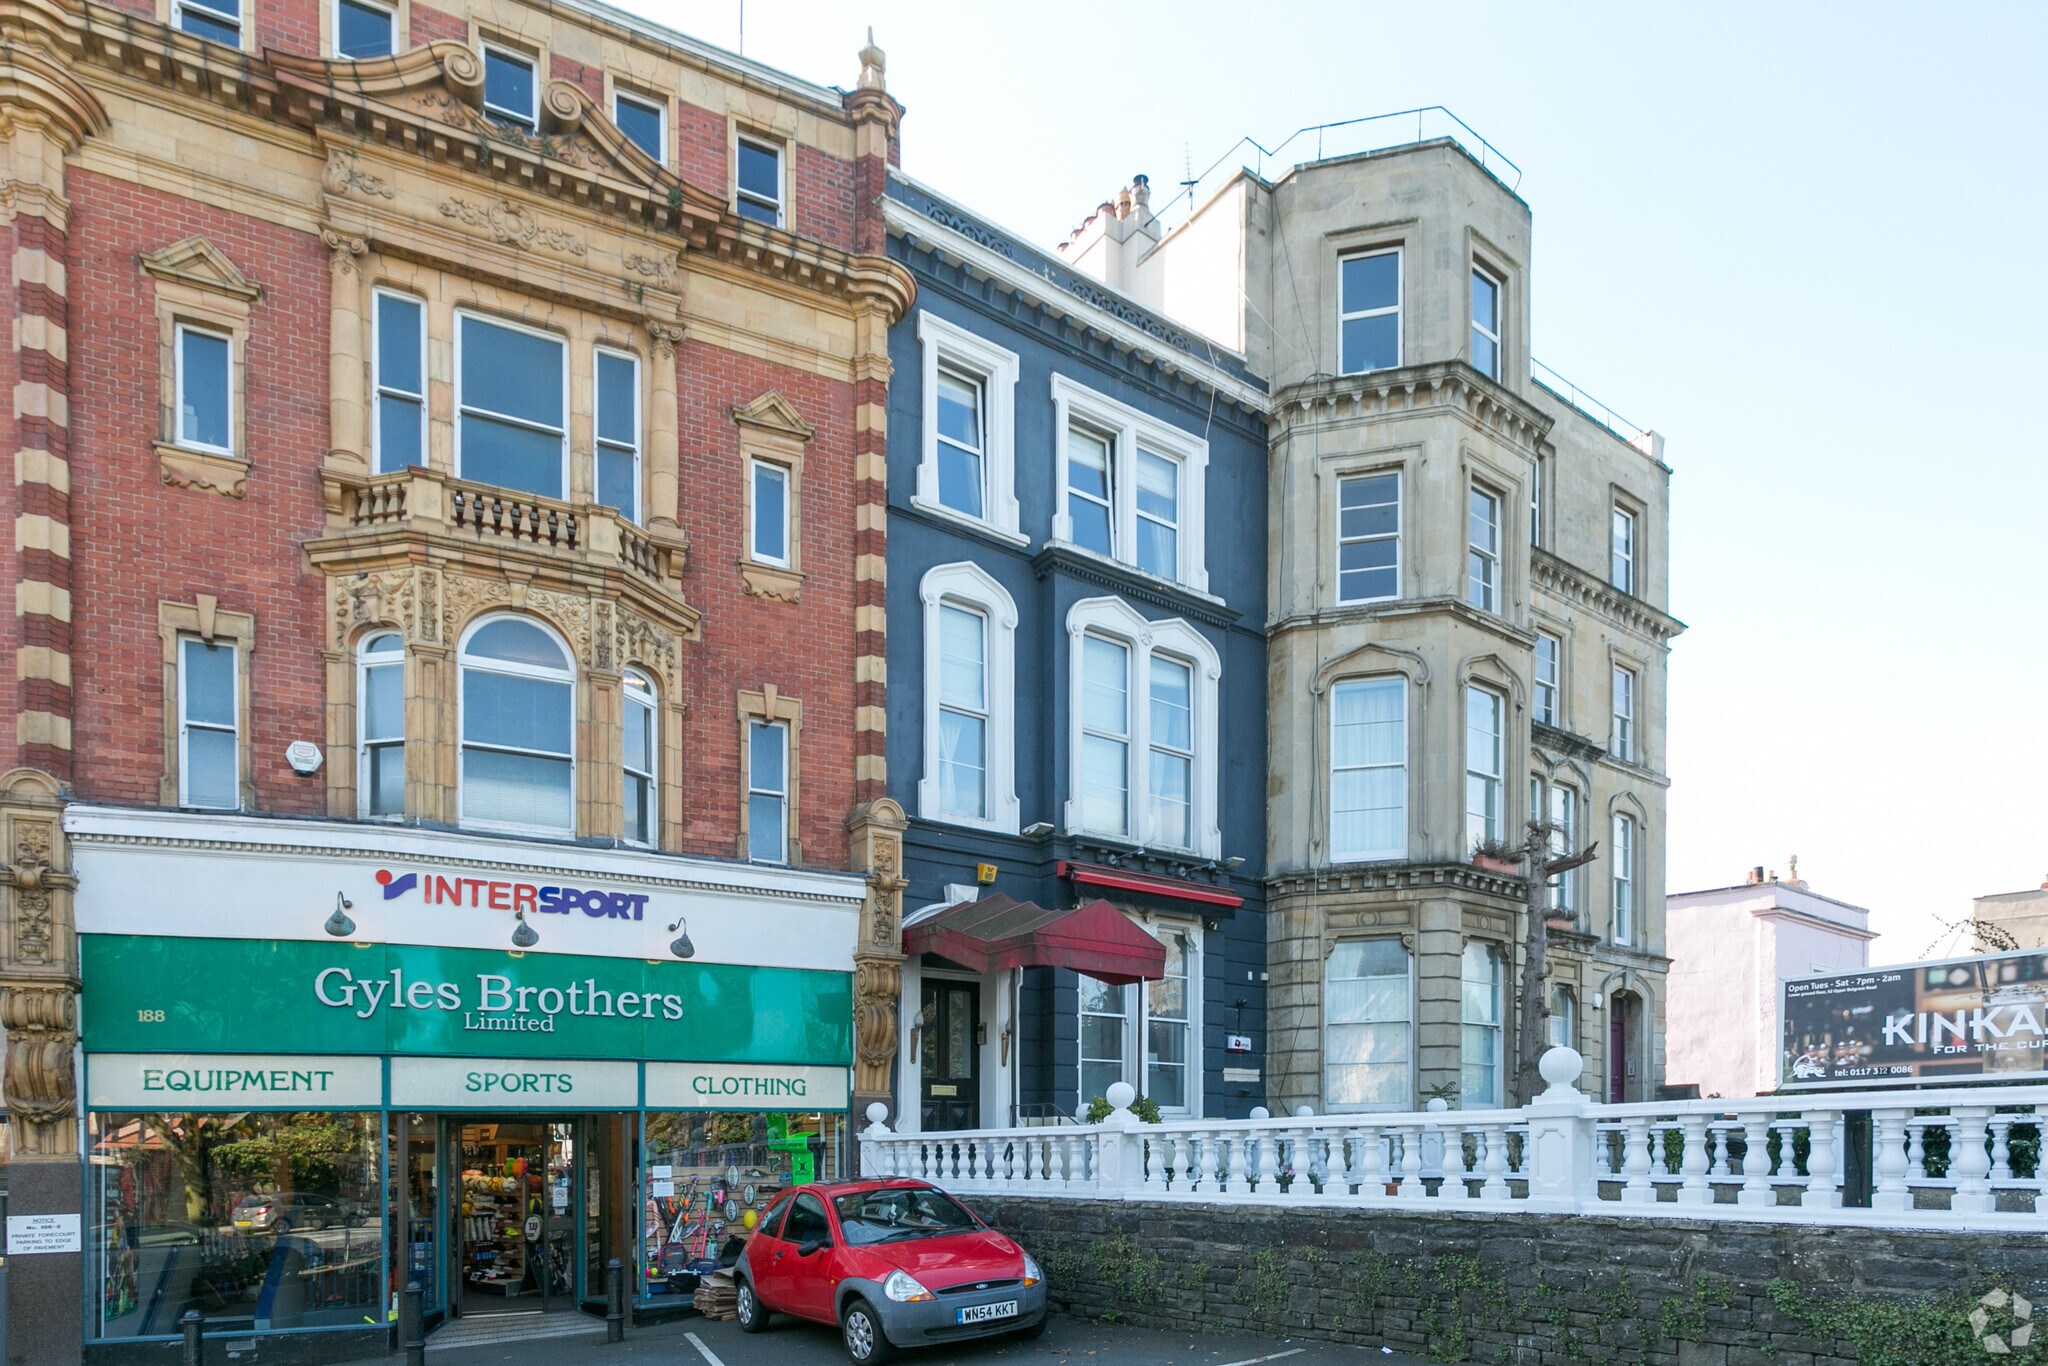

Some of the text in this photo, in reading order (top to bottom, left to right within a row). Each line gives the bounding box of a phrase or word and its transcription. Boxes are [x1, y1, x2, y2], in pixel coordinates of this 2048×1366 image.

[424, 873, 649, 921] INTERSPORT
[314, 967, 684, 1021] Gyles Brothers
[1788, 984, 1809, 993] Open
[1811, 982, 1829, 990] Tues
[1835, 979, 1849, 988] Sat
[1856, 977, 1875, 986] 7pm
[1882, 975, 1901, 983] 2am
[137, 1009, 166, 1023] 188
[464, 1012, 555, 1033] Limited
[1881, 1003, 2048, 1046] KINKA
[1933, 1045, 1967, 1055] FOR
[1974, 1042, 2008, 1052] THE
[143, 1069, 334, 1092] EQUIPMENT
[1834, 1069, 1848, 1077] tel:
[1850, 1068, 1871, 1076] 0117
[1890, 1065, 1913, 1074] 0086
[465, 1072, 573, 1093] SPORTS
[692, 1075, 807, 1097] CLOTHING
[964, 1302, 1015, 1321] WN54 KKT
